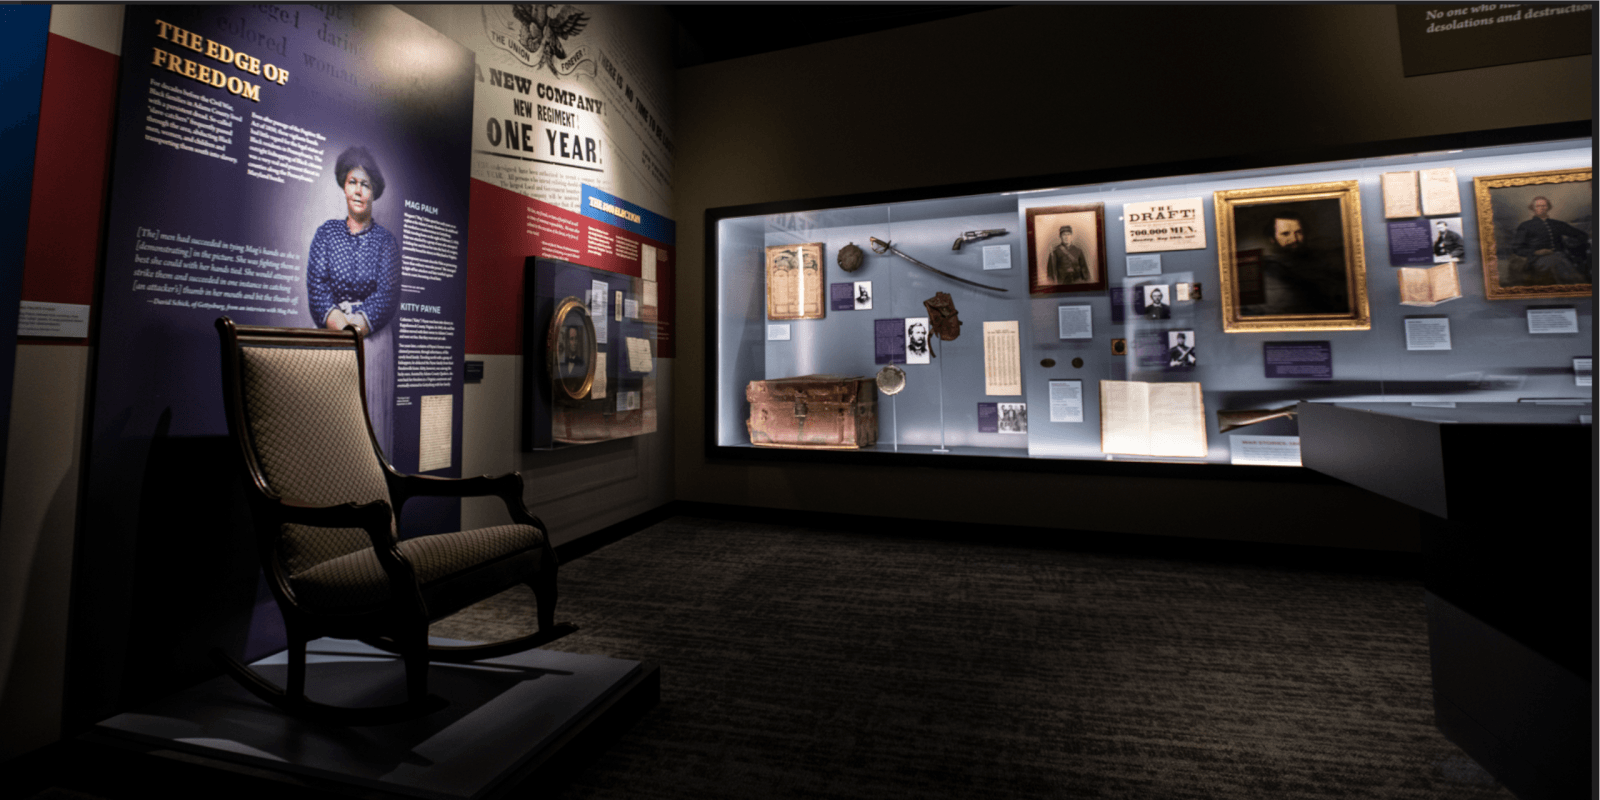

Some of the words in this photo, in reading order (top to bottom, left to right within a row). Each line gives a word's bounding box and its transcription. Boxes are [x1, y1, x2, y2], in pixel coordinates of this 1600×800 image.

[1425, 9, 1444, 21] No
[1446, 8, 1469, 18] one
[1470, 3, 1497, 14] who
[1426, 18, 1494, 33] desolations
[1496, 10, 1522, 23] and
[155, 19, 203, 53] THE
[204, 39, 261, 75] EDGE
[263, 63, 289, 85] OF
[491, 31, 505, 45] THE
[508, 39, 530, 62] UNION
[152, 47, 261, 102] FREEDOM
[489, 67, 532, 95] NEW
[536, 82, 607, 116] COMPANY!
[514, 98, 532, 118] NEW
[487, 117, 534, 153] ONE
[545, 128, 602, 165] YEAR!
[404, 200, 420, 211] MAG
[421, 204, 438, 215] PALM
[1129, 208, 1196, 222] DRAFT!
[400, 302, 420, 312] KITTY
[420, 304, 441, 314] PAYNE
